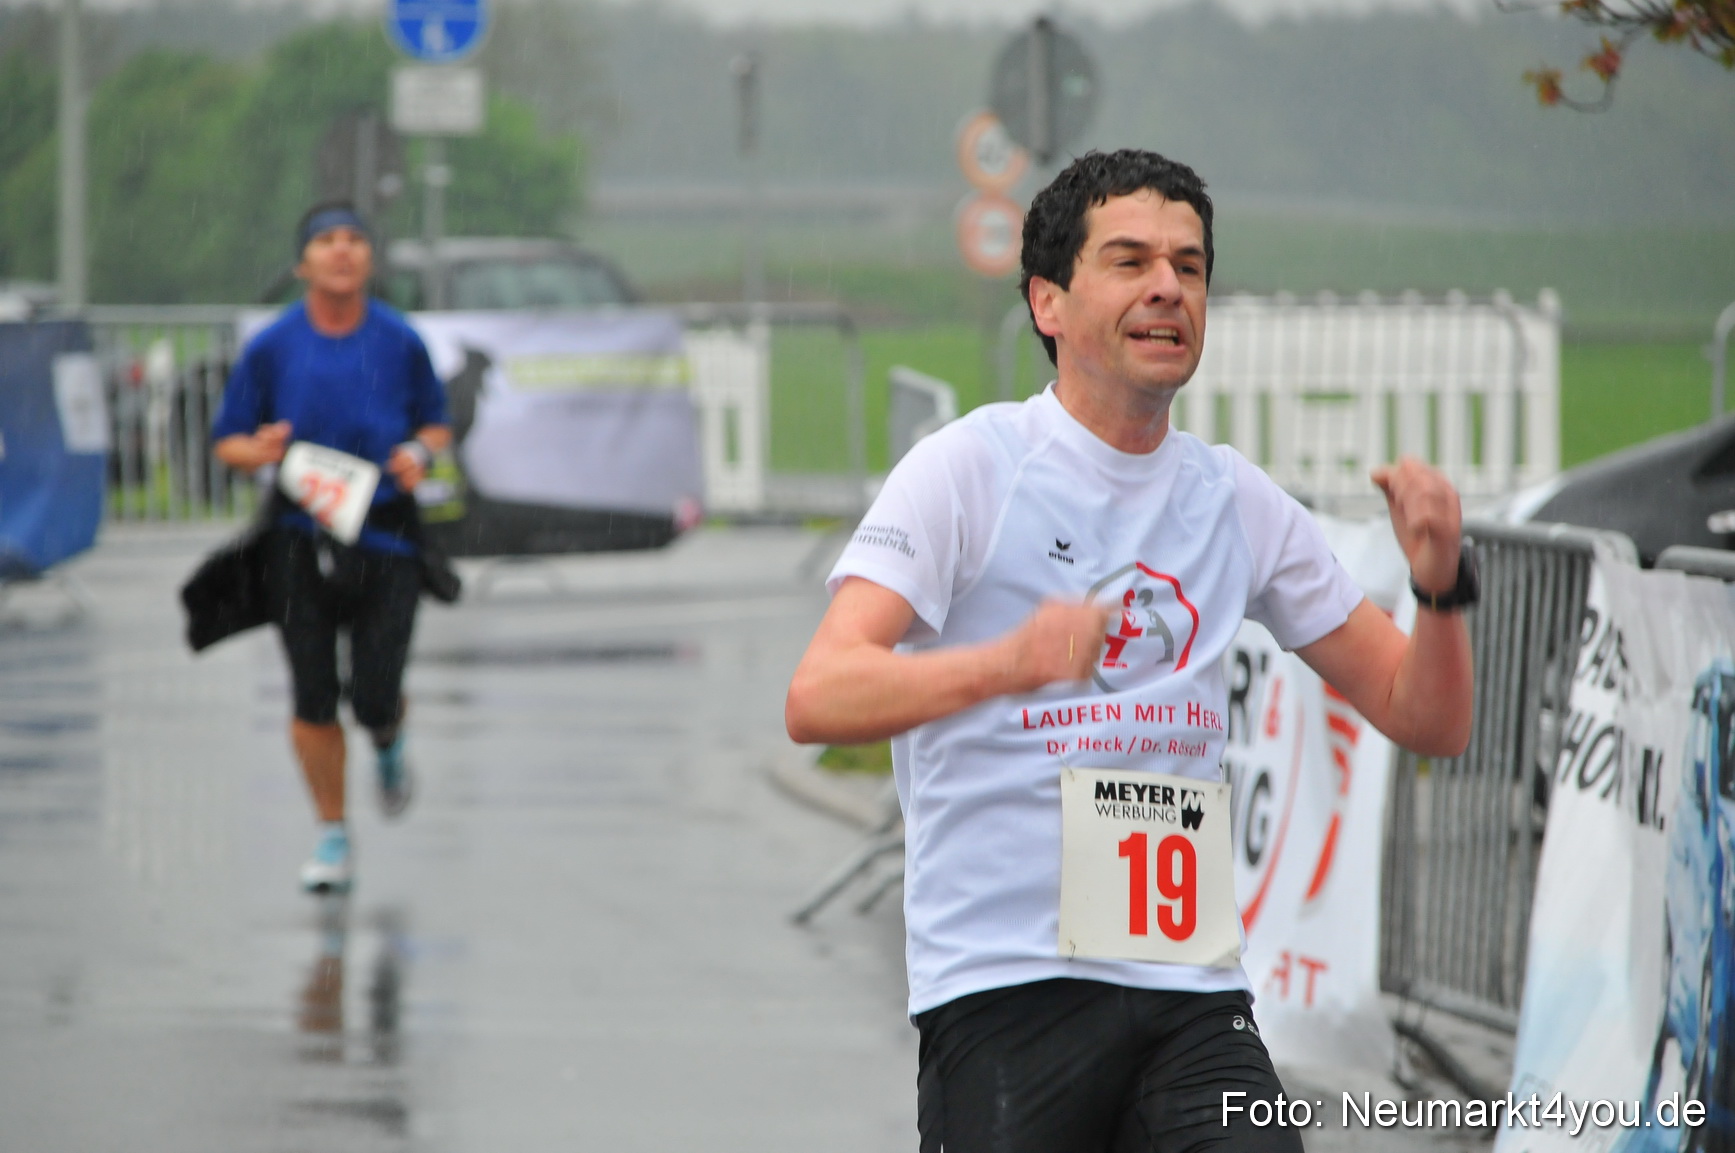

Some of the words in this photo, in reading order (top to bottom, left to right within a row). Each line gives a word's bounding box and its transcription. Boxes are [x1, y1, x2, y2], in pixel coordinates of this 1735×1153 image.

[1021, 703, 1121, 730] LAUFEN
[1135, 703, 1176, 724] MIT
[1046, 739, 1071, 756] Dr.
[1077, 735, 1123, 752] Heck
[1141, 737, 1162, 754] Dr.
[1094, 780, 1175, 806] MEYER
[1095, 802, 1177, 824] WERBUNG
[1118, 832, 1197, 941] 19
